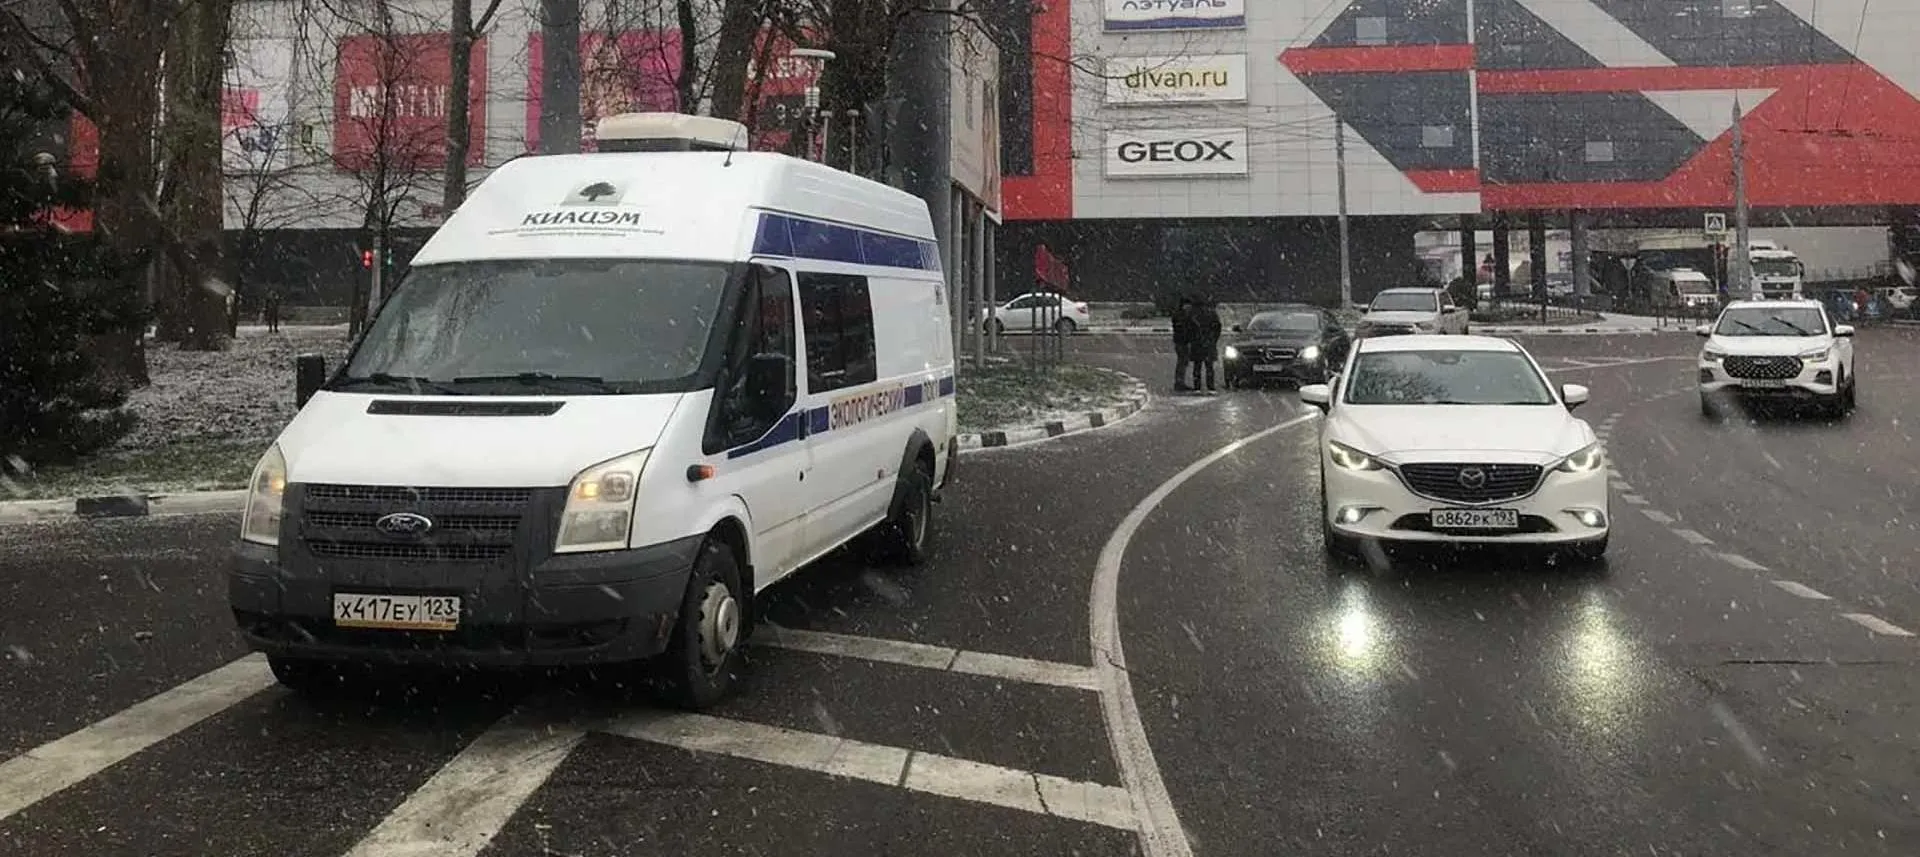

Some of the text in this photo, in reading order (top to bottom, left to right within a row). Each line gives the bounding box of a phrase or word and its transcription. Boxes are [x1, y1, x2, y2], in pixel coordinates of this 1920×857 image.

[1125, 66, 1227, 88] divan.ru
[1118, 141, 1234, 162] GEOX
[522, 211, 641, 226] КИАЦЭМ
[424, 599, 453, 615] 123
